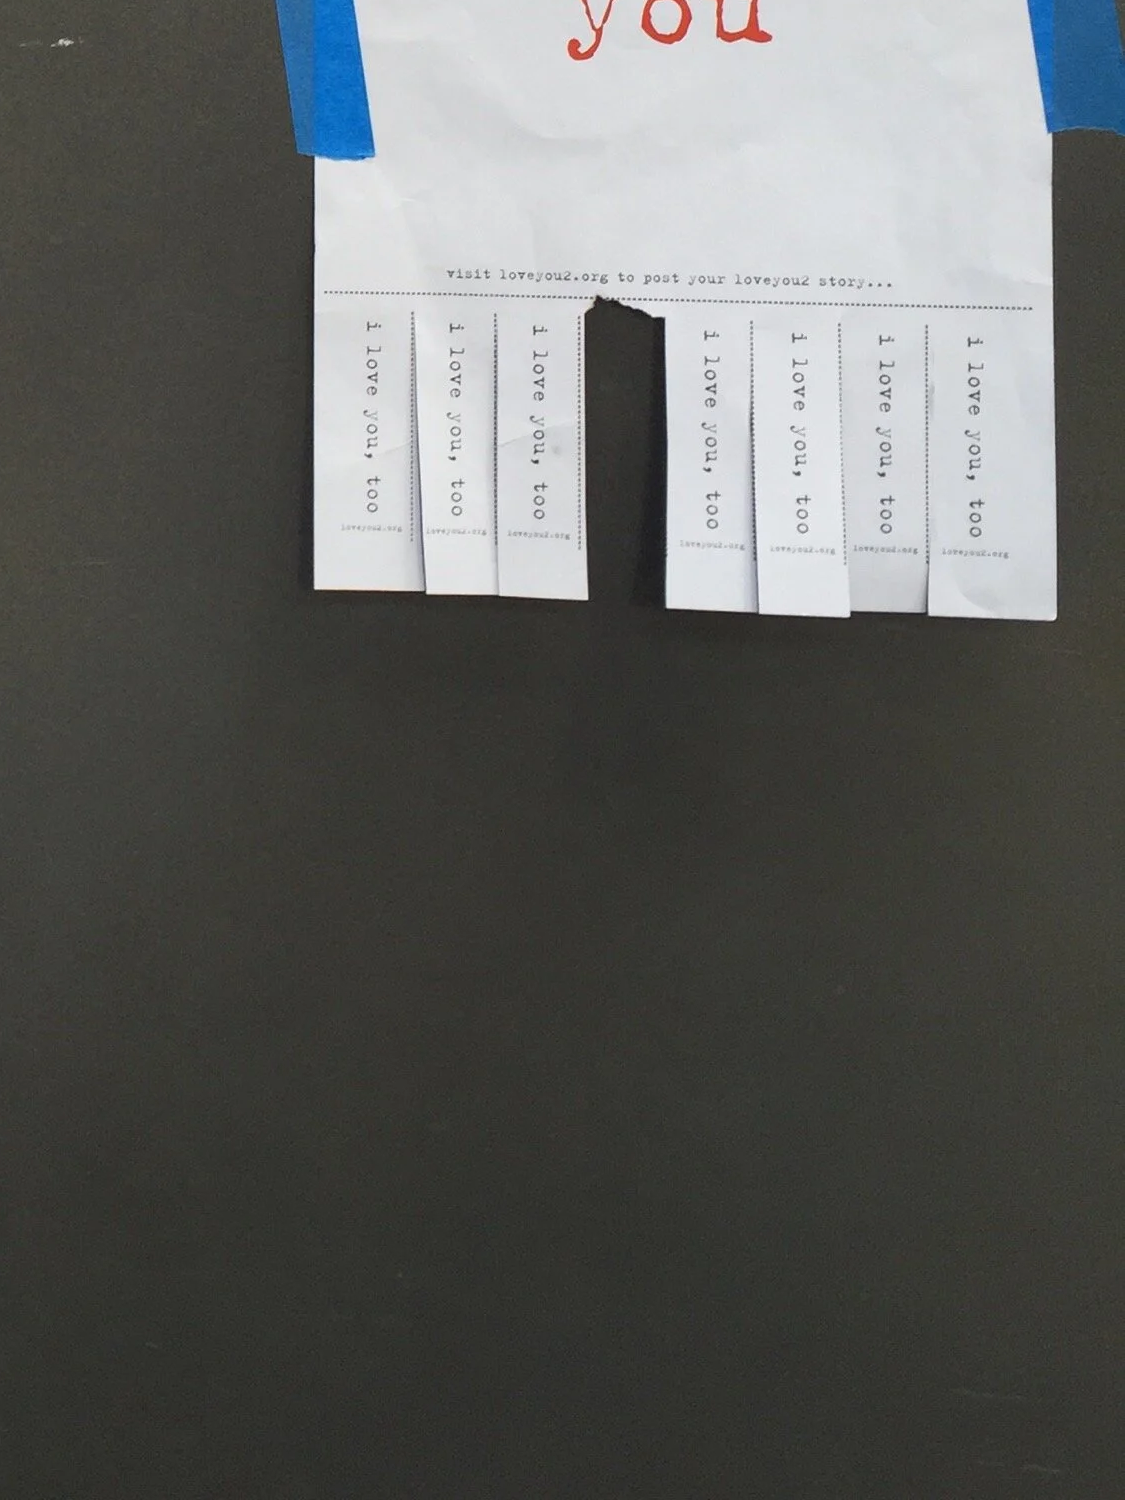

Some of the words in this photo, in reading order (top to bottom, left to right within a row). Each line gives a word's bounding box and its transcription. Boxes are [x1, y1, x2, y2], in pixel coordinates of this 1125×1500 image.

[446, 268, 491, 280] visit
[499, 268, 609, 285] loveyou2.org
[617, 271, 635, 283] to
[642, 272, 680, 286] post
[687, 275, 727, 287] your
[734, 273, 810, 288] loveyou2
[818, 275, 892, 290] story...
[366, 320, 382, 333] i
[448, 322, 465, 334] i
[532, 324, 549, 337] i
[703, 329, 720, 342] i
[791, 332, 808, 344] i
[878, 334, 895, 346] i
[966, 336, 984, 348] i
[365, 345, 382, 396] love
[448, 347, 465, 399] love
[532, 350, 549, 402] love
[703, 355, 721, 409] love
[791, 357, 809, 412] love
[878, 359, 896, 413] love
[967, 362, 985, 416] love
[362, 409, 379, 459] you,
[446, 411, 462, 462] you,
[528, 414, 546, 465] you,
[700, 421, 718, 474] you,
[789, 424, 807, 477] you,
[874, 426, 893, 478] you,
[963, 429, 982, 481] you,
[366, 475, 382, 514] too
[450, 478, 466, 517] too
[532, 481, 549, 521] too
[705, 490, 722, 530] too
[795, 494, 812, 535] too
[879, 494, 896, 535] too
[968, 498, 986, 538] too
